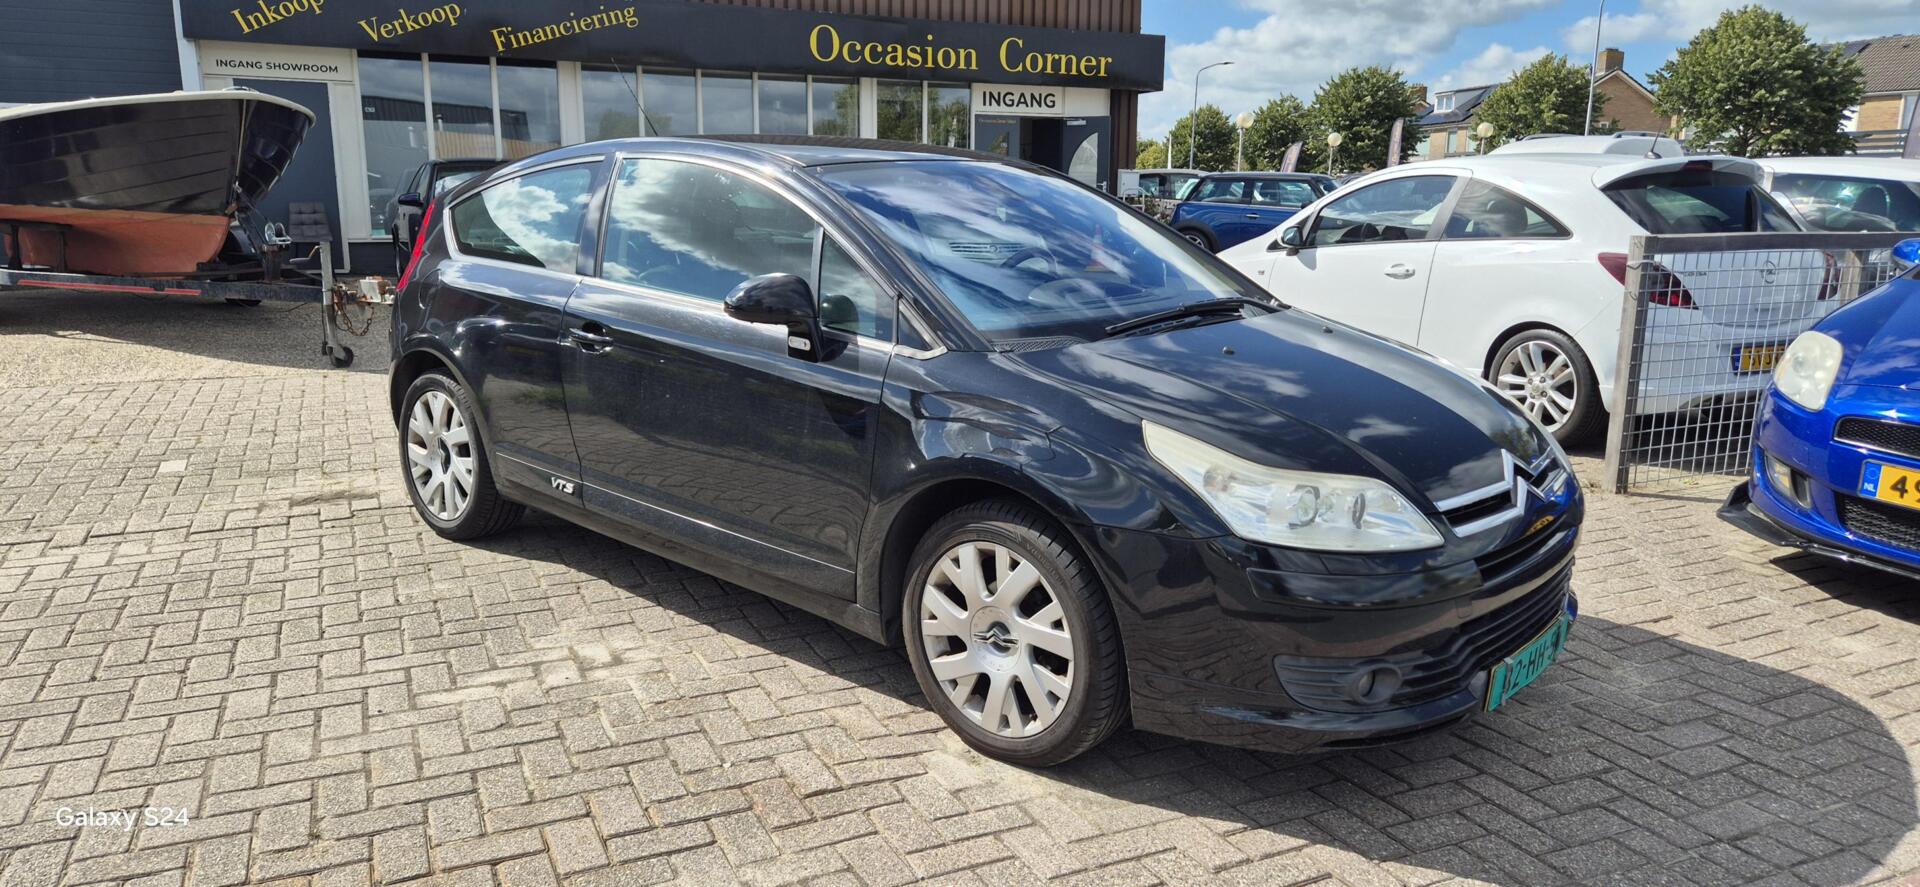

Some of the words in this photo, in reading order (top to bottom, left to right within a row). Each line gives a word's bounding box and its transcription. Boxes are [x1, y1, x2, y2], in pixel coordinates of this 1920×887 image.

[230, 0, 325, 34] Inkoop
[357, 2, 462, 43] Verkoop
[489, 5, 639, 52] Financiering
[809, 24, 979, 70] Occasion
[999, 37, 1113, 77] Corner
[215, 59, 263, 70] INGANG
[265, 62, 339, 73] SHOWROOM
[982, 90, 1056, 109] INGANG
[551, 476, 576, 495] VTS
[1863, 482, 1876, 492] NL
